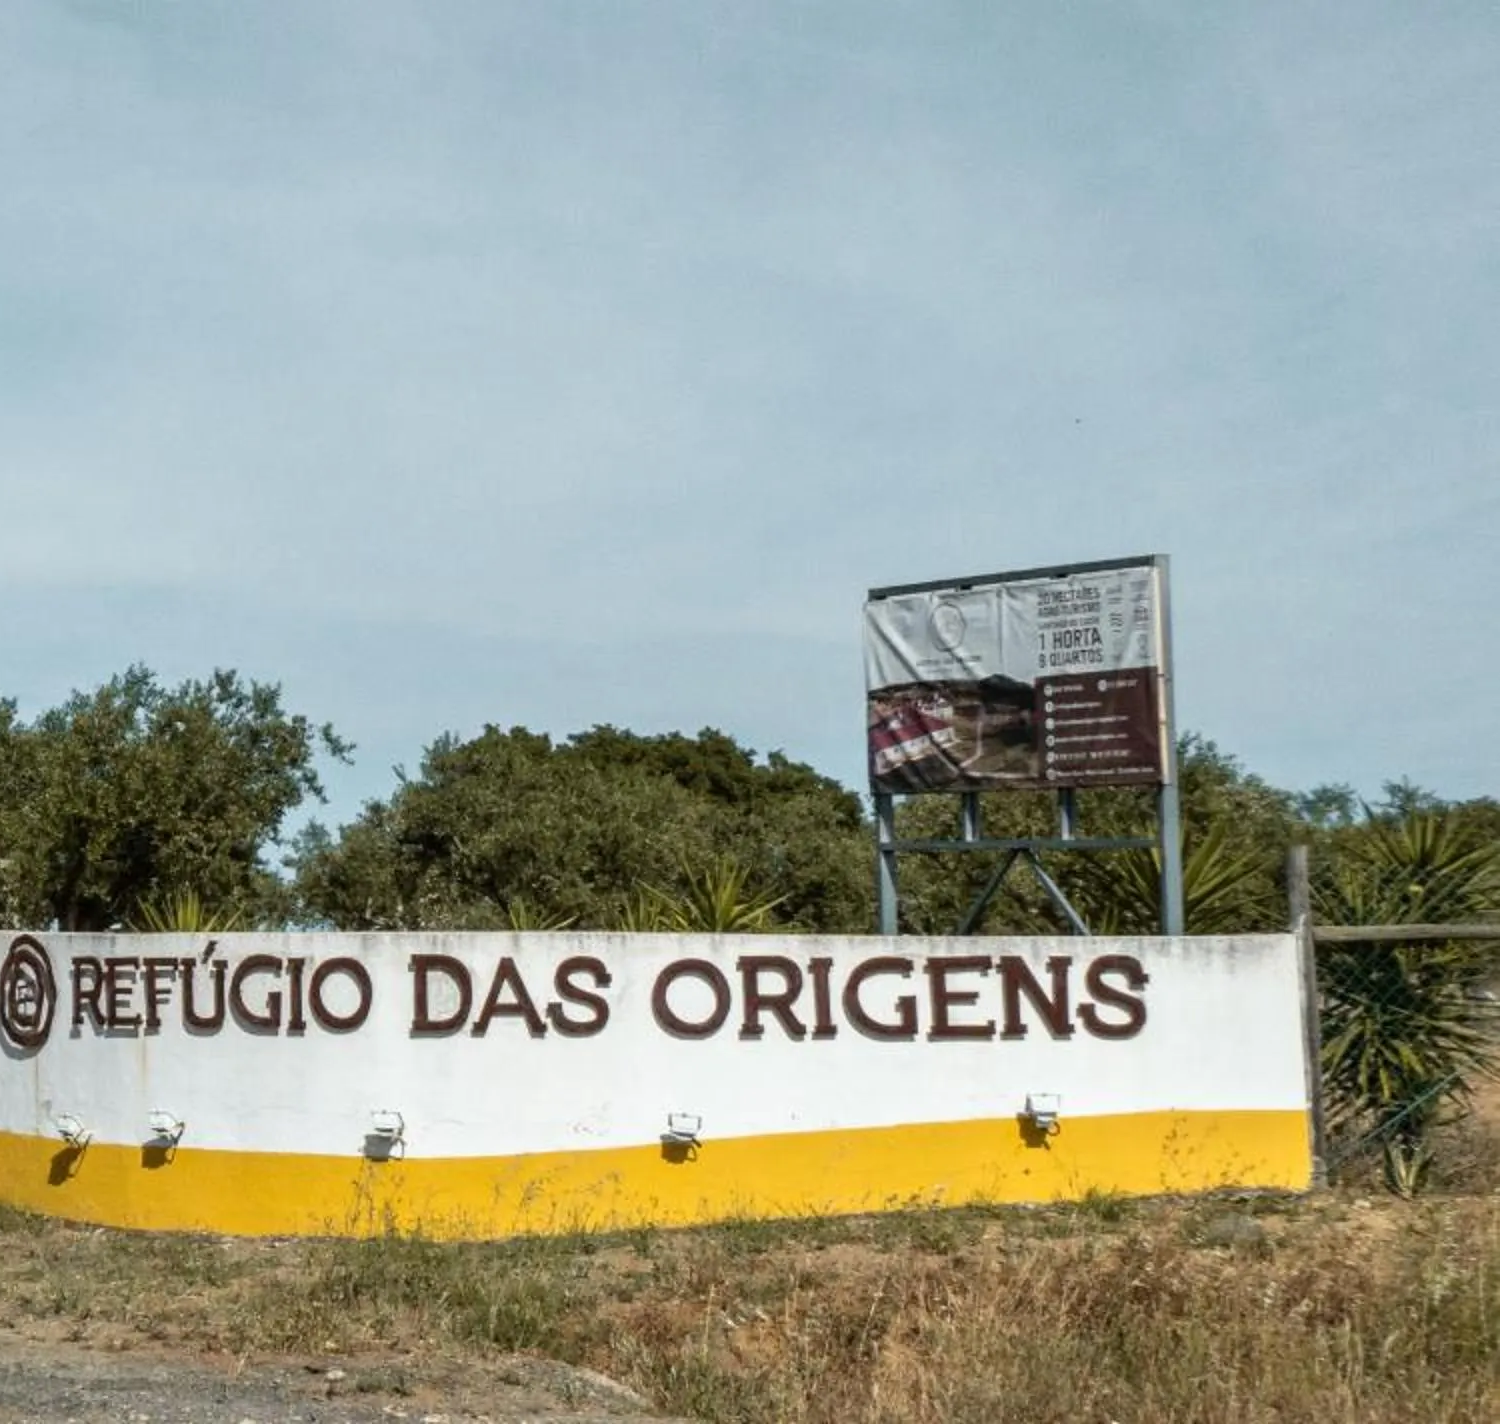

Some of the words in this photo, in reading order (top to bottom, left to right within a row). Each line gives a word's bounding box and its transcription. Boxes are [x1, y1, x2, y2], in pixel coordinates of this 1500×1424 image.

[1039, 632, 1045, 650] 1
[1052, 627, 1103, 650] HORTA
[1049, 647, 1104, 667] QUARTOS
[71, 940, 373, 1037] REFÚGIO
[410, 953, 612, 1037] DAS
[651, 954, 1150, 1041] ORIGENS
